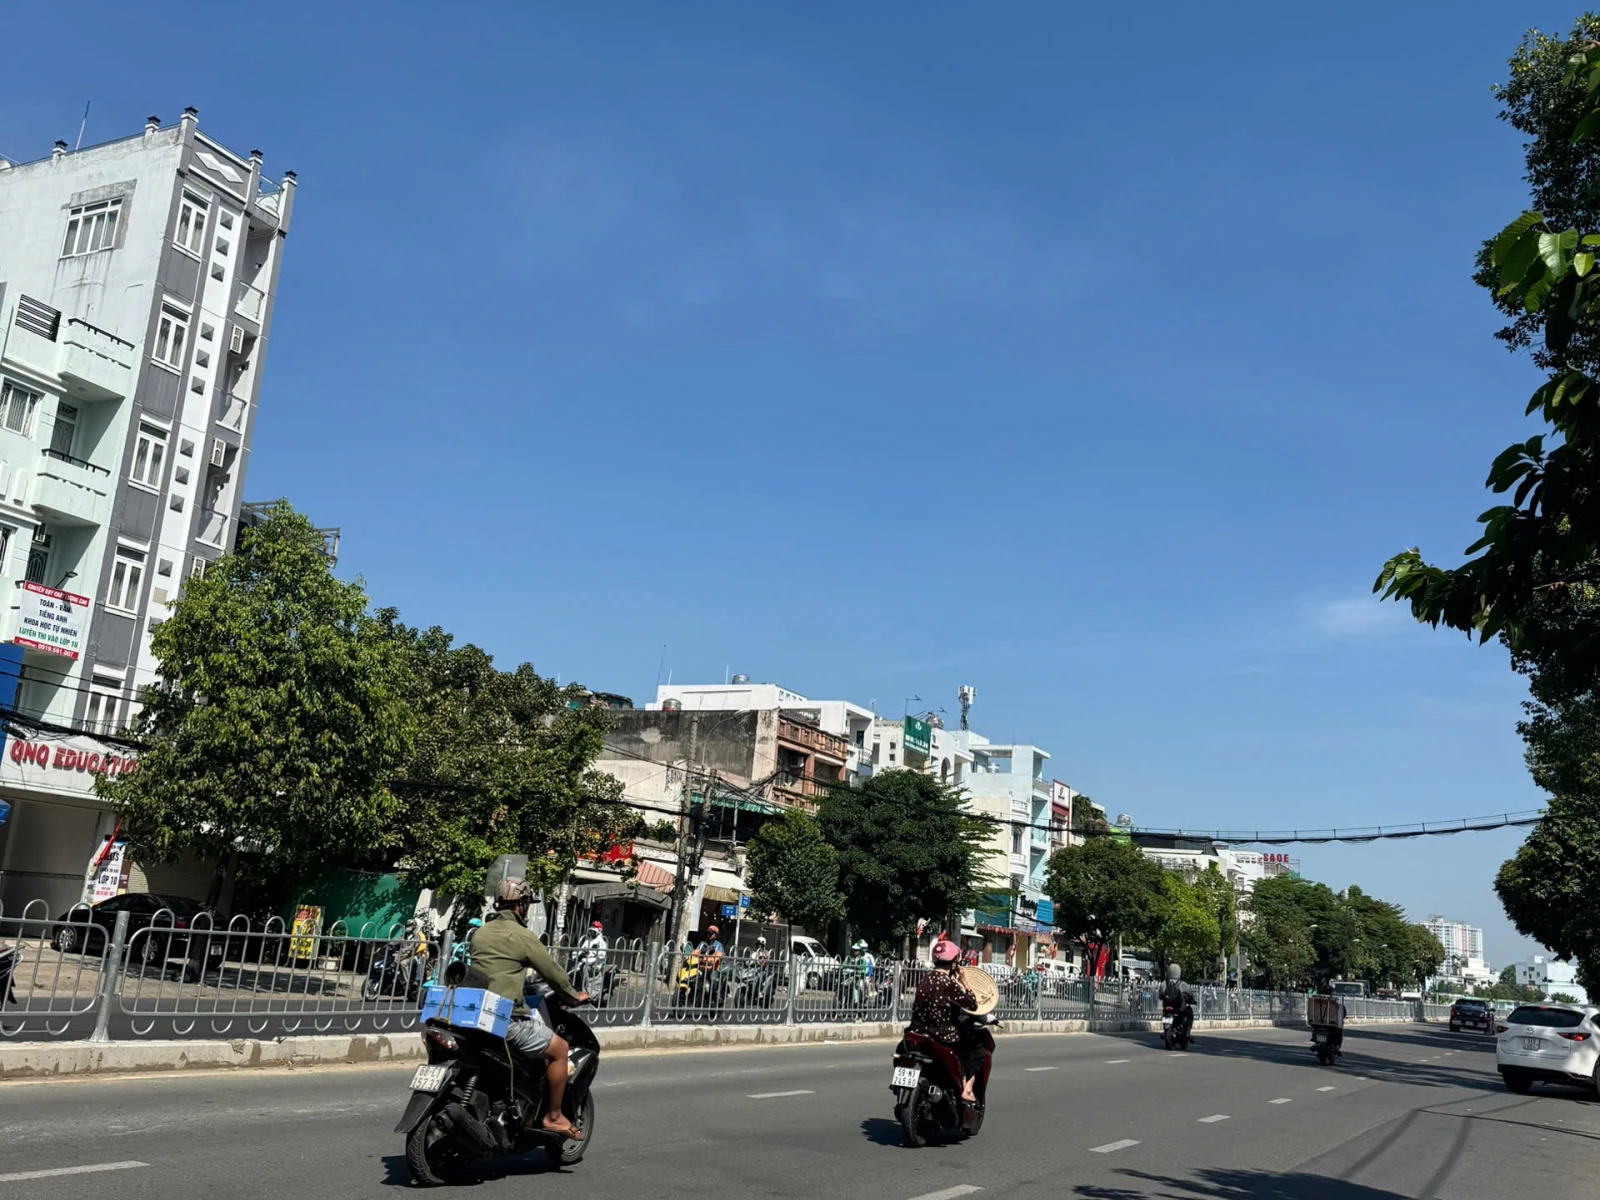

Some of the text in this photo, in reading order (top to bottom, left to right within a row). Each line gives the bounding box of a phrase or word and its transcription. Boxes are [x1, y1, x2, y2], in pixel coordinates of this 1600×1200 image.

[24, 617, 38, 626] KHOA
[56, 615, 68, 624] ANH
[38, 632, 46, 640] THI
[10, 740, 139, 776] QNQ EDUCATIO
[110, 876, 118, 885] 10
